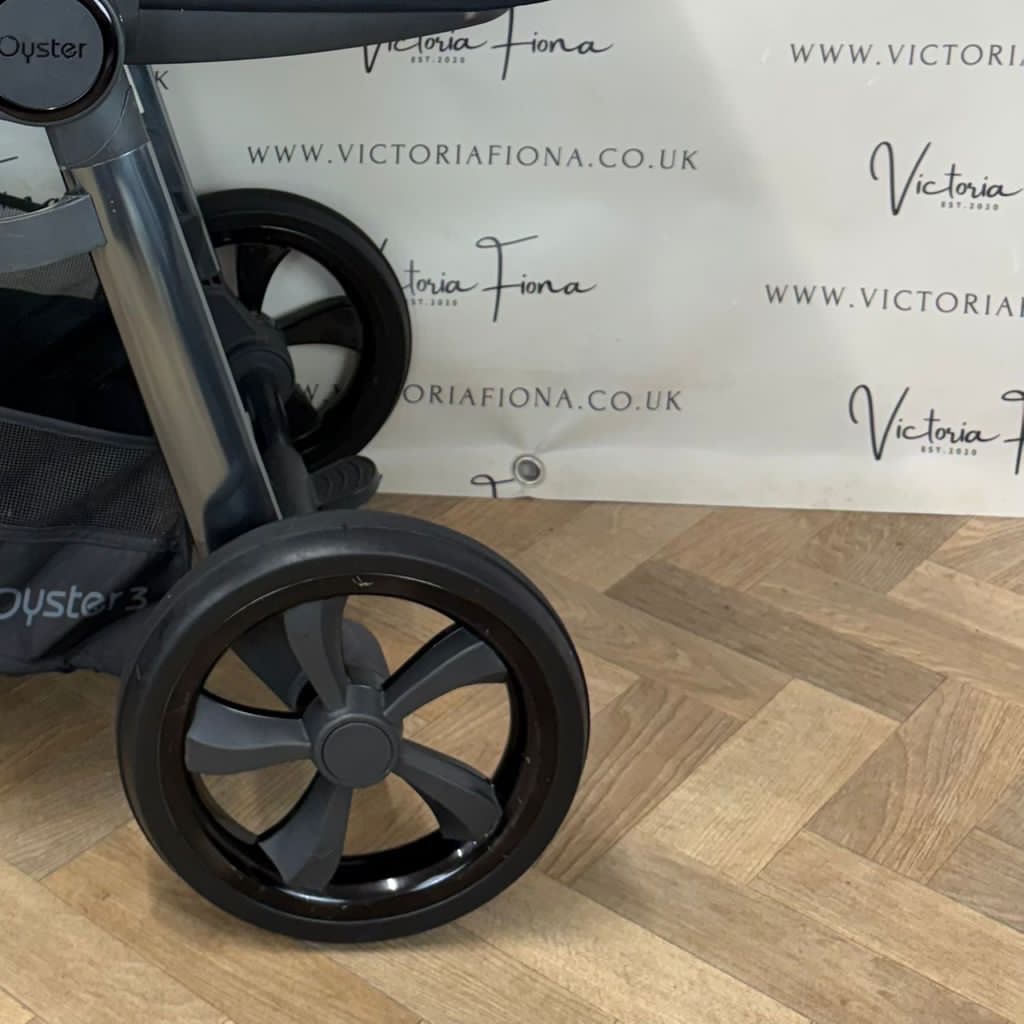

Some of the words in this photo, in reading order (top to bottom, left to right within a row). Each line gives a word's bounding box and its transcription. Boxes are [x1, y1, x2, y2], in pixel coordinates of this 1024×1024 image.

[491, 8, 614, 81] Fiona
[248, 144, 697, 170] WWW.VICTORIAFIONA.CO.UK
[870, 141, 1023, 216] Victoria
[476, 235, 597, 323] Fiona
[765, 284, 1024, 318] WWW.VICTORIA
[849, 384, 1000, 462] Victoria
